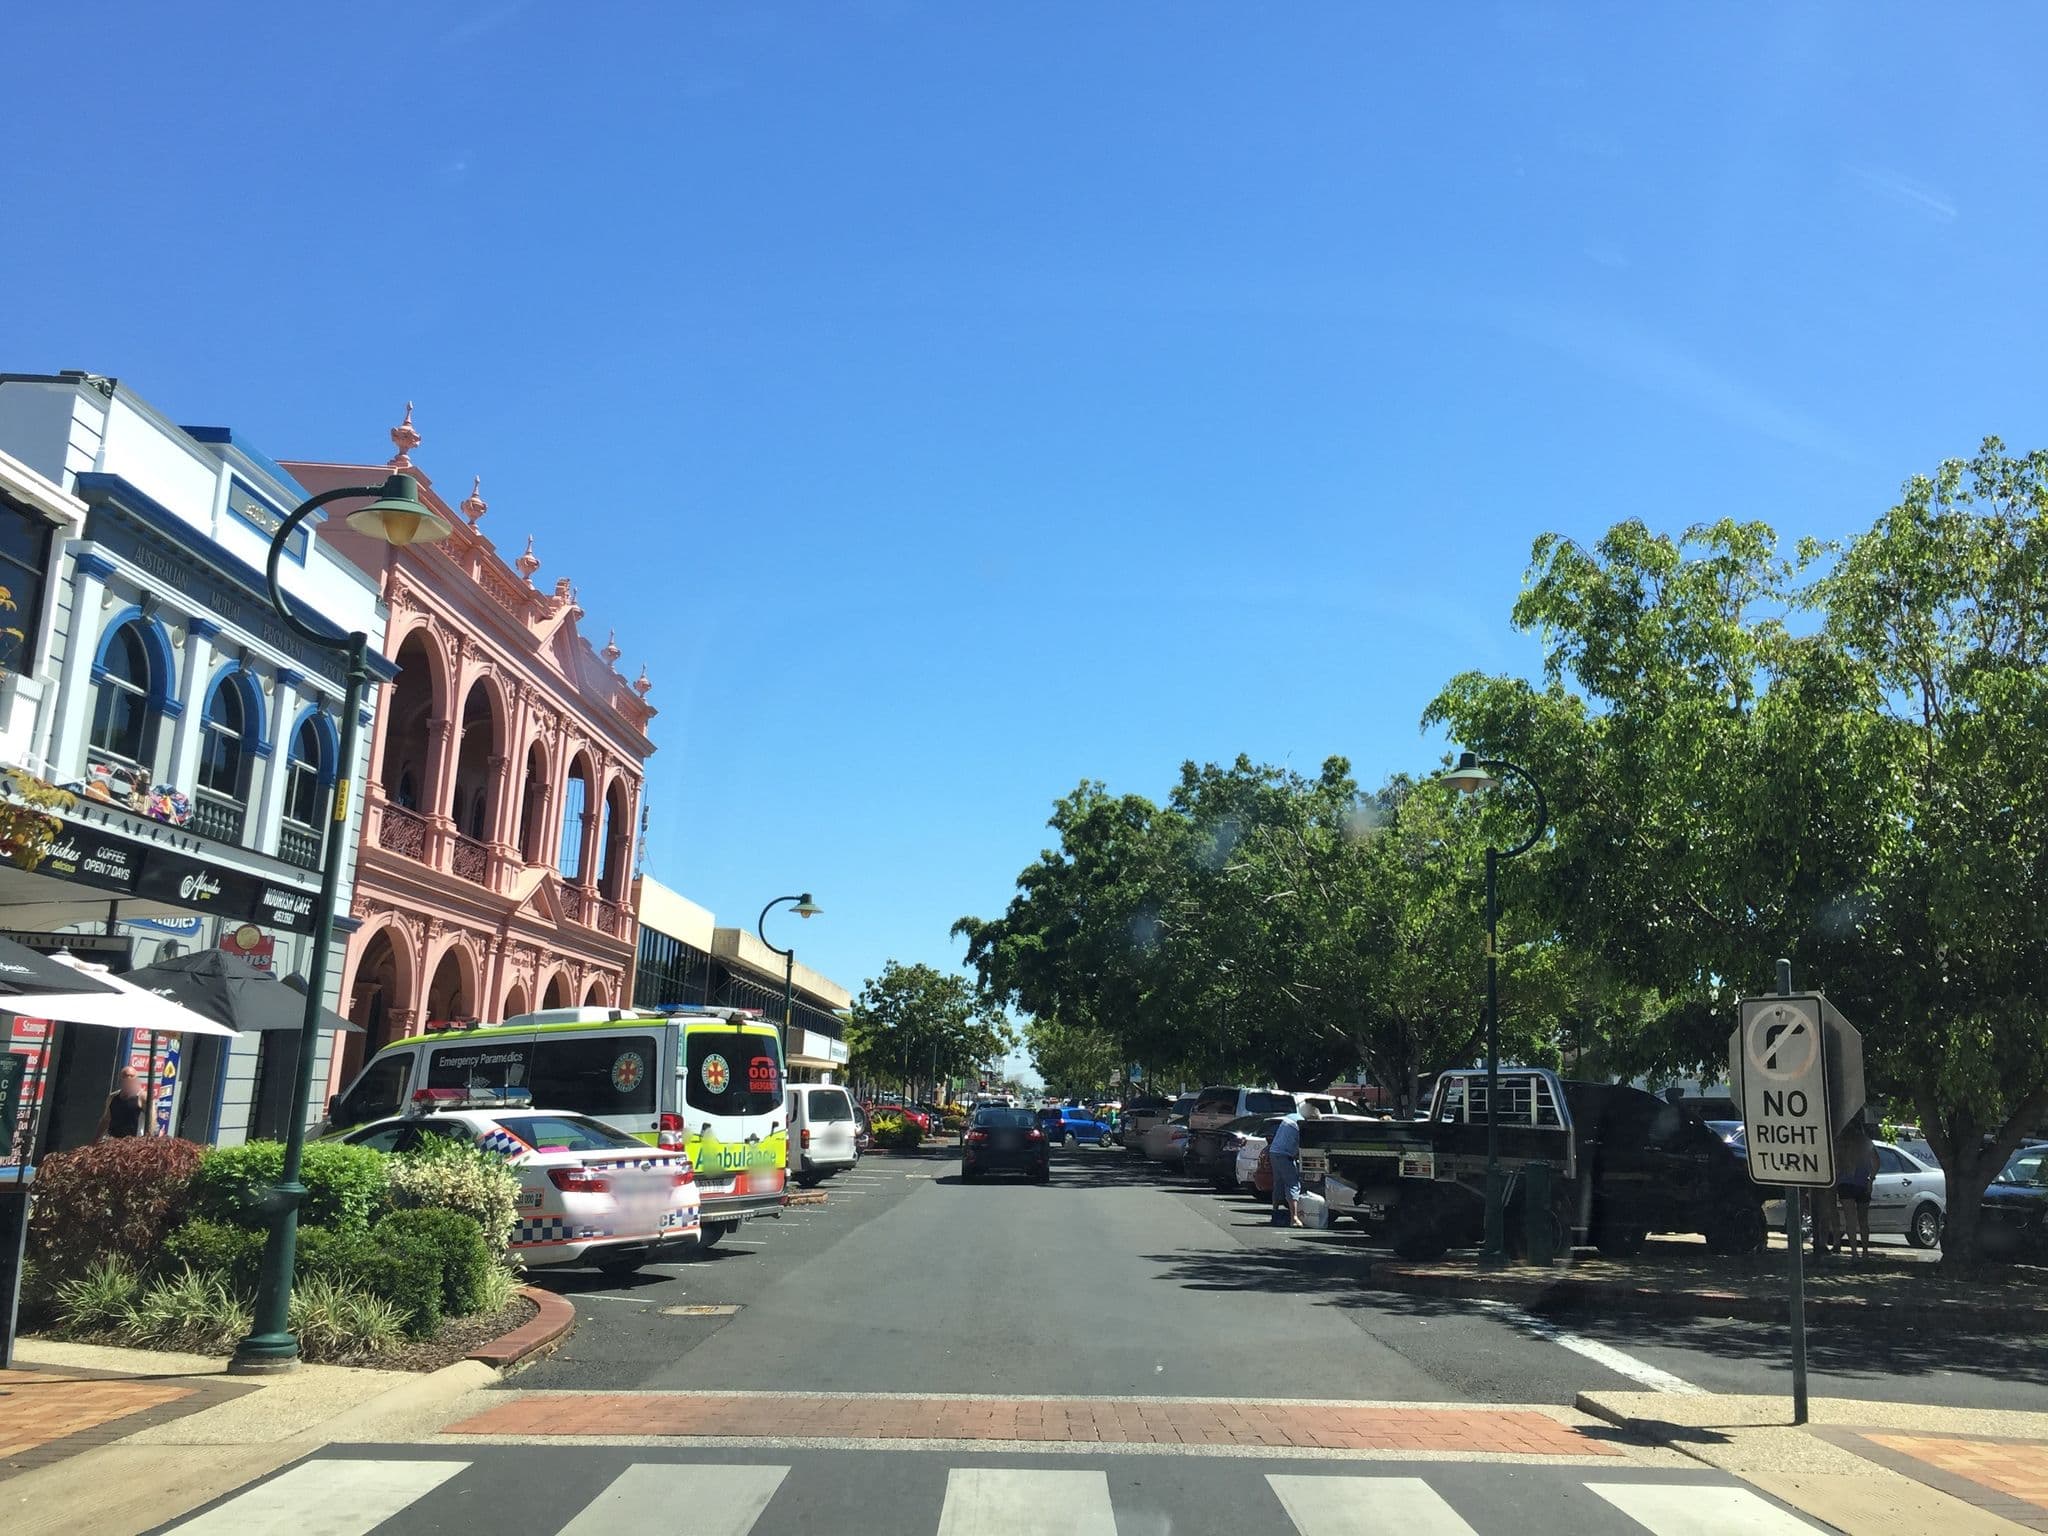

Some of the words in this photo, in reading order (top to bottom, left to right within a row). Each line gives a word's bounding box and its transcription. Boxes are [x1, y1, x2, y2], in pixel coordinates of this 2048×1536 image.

[135, 544, 189, 588] AUSTRALIAN
[263, 624, 304, 660] PROVIDENT
[97, 846, 127, 864] COFFEE
[83, 858, 106, 874] OPEN
[105, 864, 112, 875] 7
[110, 865, 131, 880] DAYS
[293, 895, 312, 915] CAFE
[439, 1056, 480, 1069] Emergency
[479, 1051, 524, 1064] Paramedics
[748, 1066, 777, 1079] 000
[1763, 1090, 1808, 1117] NO
[1756, 1125, 1818, 1145] RIGHT
[695, 1145, 777, 1169] Abulance
[1758, 1152, 1818, 1173] TURN
